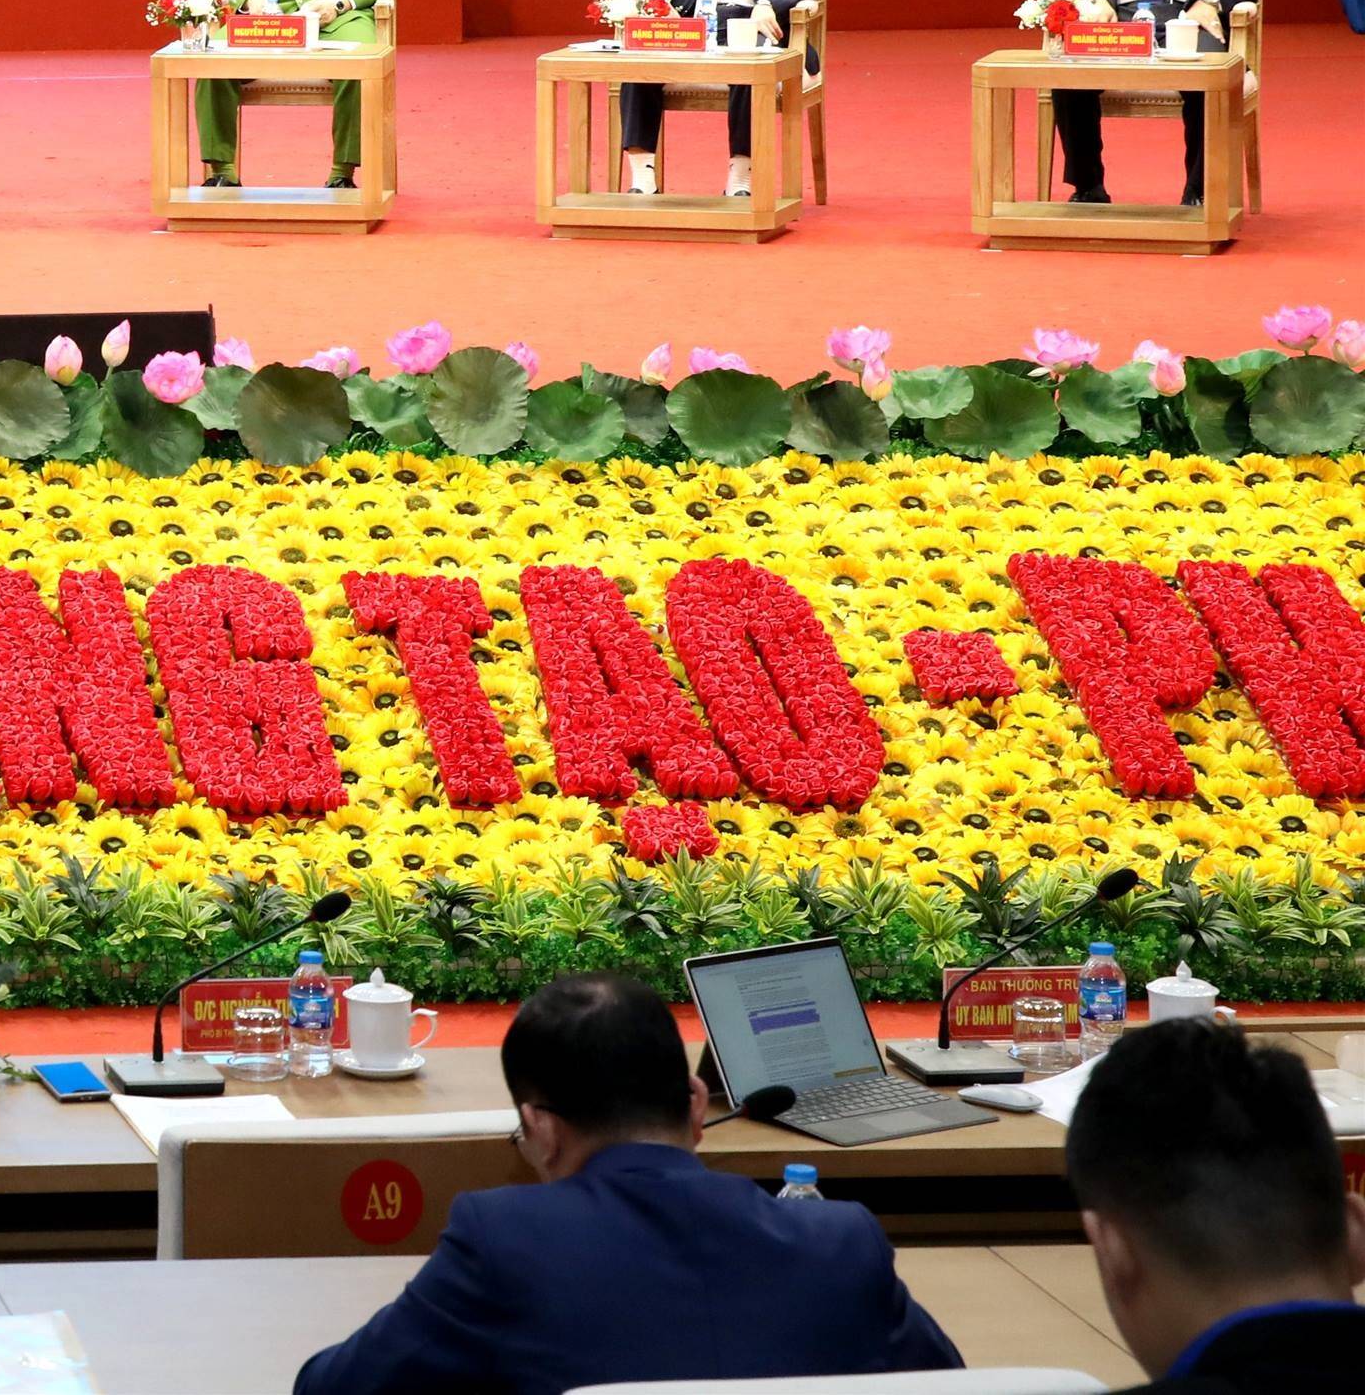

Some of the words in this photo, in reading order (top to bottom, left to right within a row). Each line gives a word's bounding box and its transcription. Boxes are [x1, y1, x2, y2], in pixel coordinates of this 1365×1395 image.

[341, 556, 887, 864] TẠO
[970, 979, 996, 993] BAN
[972, 1005, 994, 1026] BAN
[363, 1181, 402, 1220] A9
